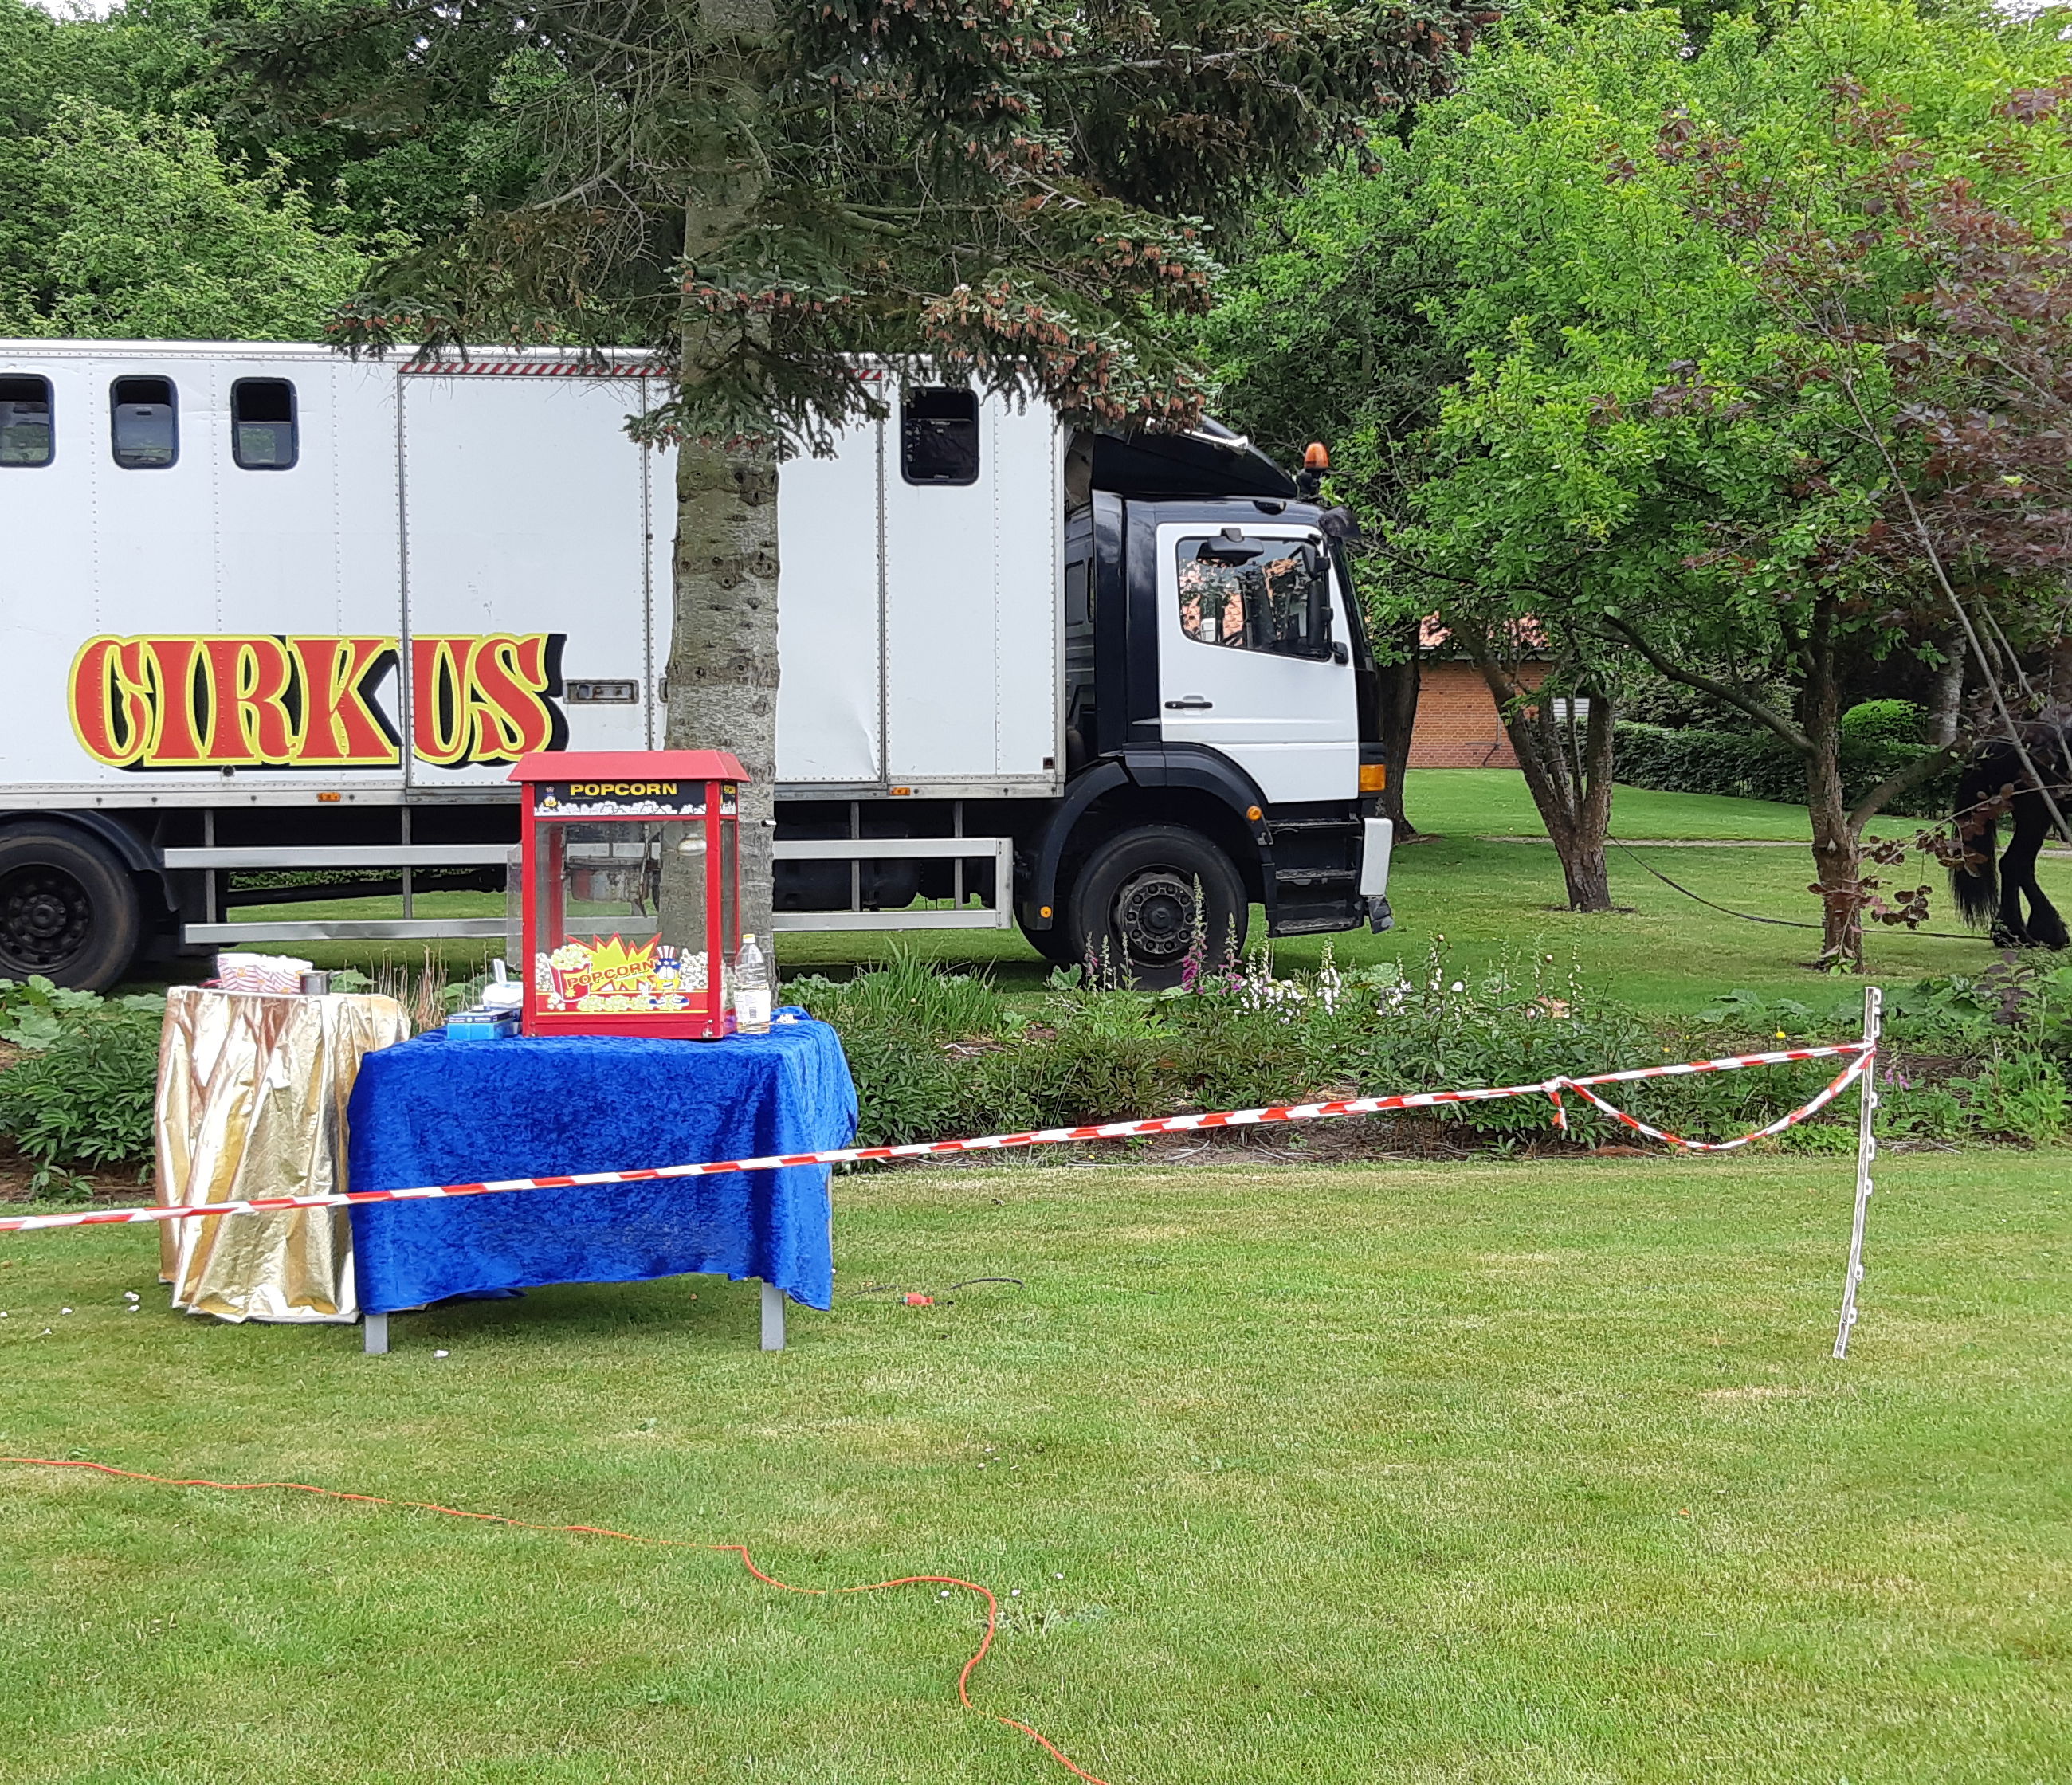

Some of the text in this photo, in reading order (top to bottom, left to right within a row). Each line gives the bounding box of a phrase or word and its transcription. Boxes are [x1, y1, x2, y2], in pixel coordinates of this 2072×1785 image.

[69, 634, 566, 770] CIRKUS
[570, 783, 677, 796] POPCORN
[567, 959, 656, 988] POPCORN
